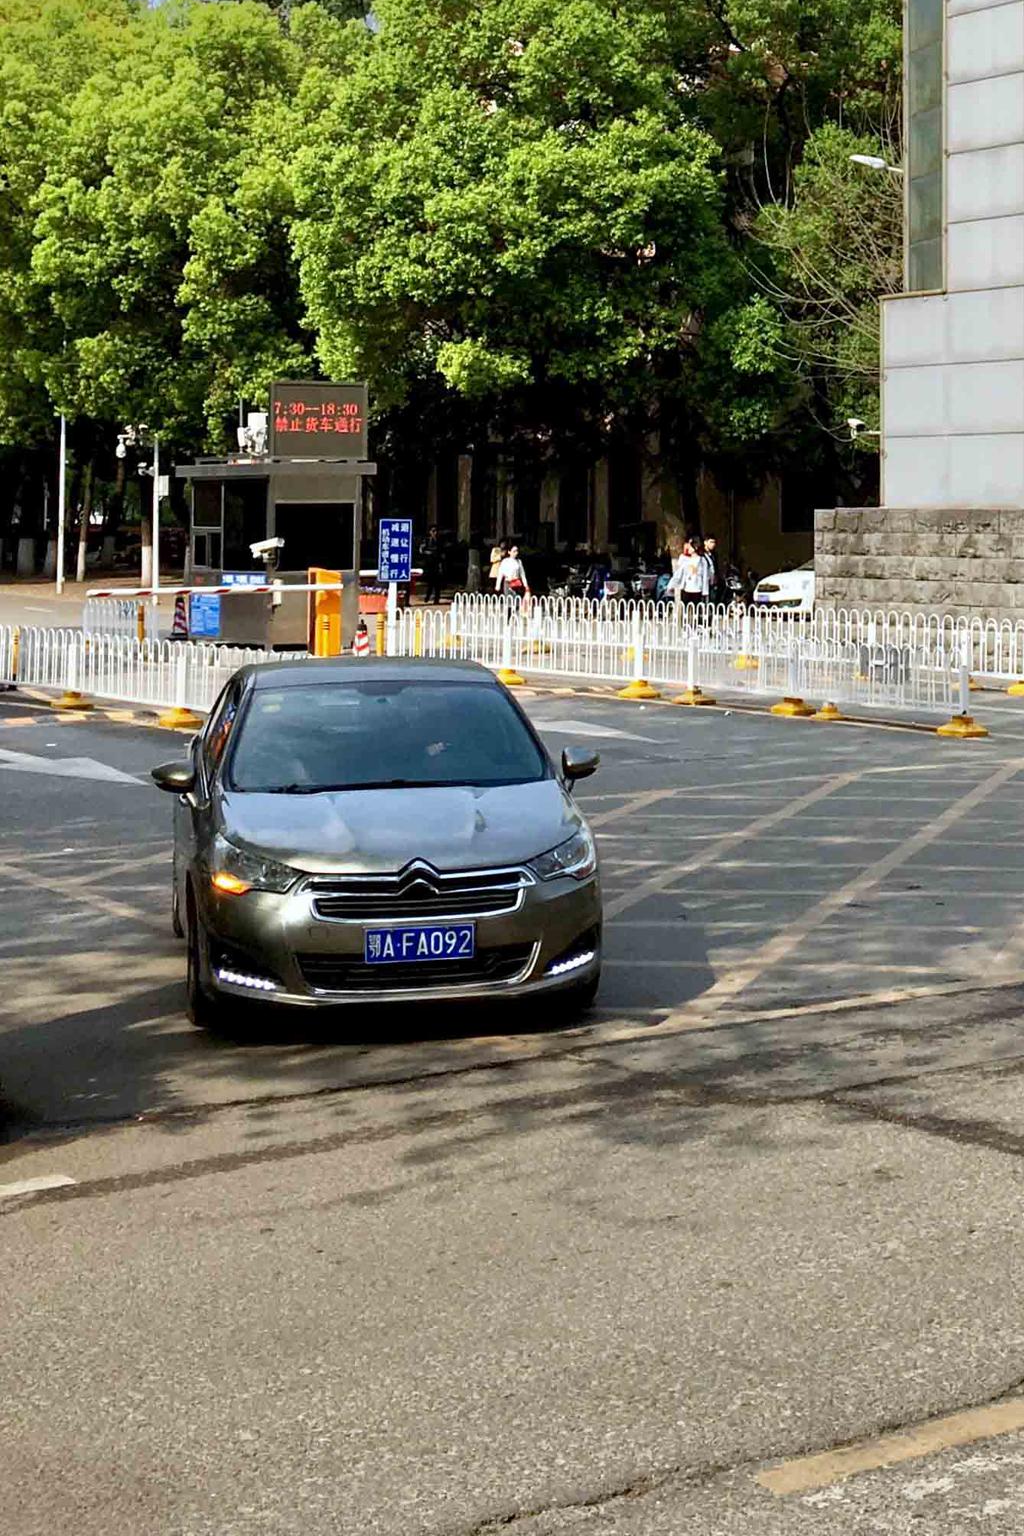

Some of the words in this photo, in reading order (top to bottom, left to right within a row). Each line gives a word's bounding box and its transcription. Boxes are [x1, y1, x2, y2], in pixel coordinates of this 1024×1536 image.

[275, 416, 362, 433] 禁止货车通行
